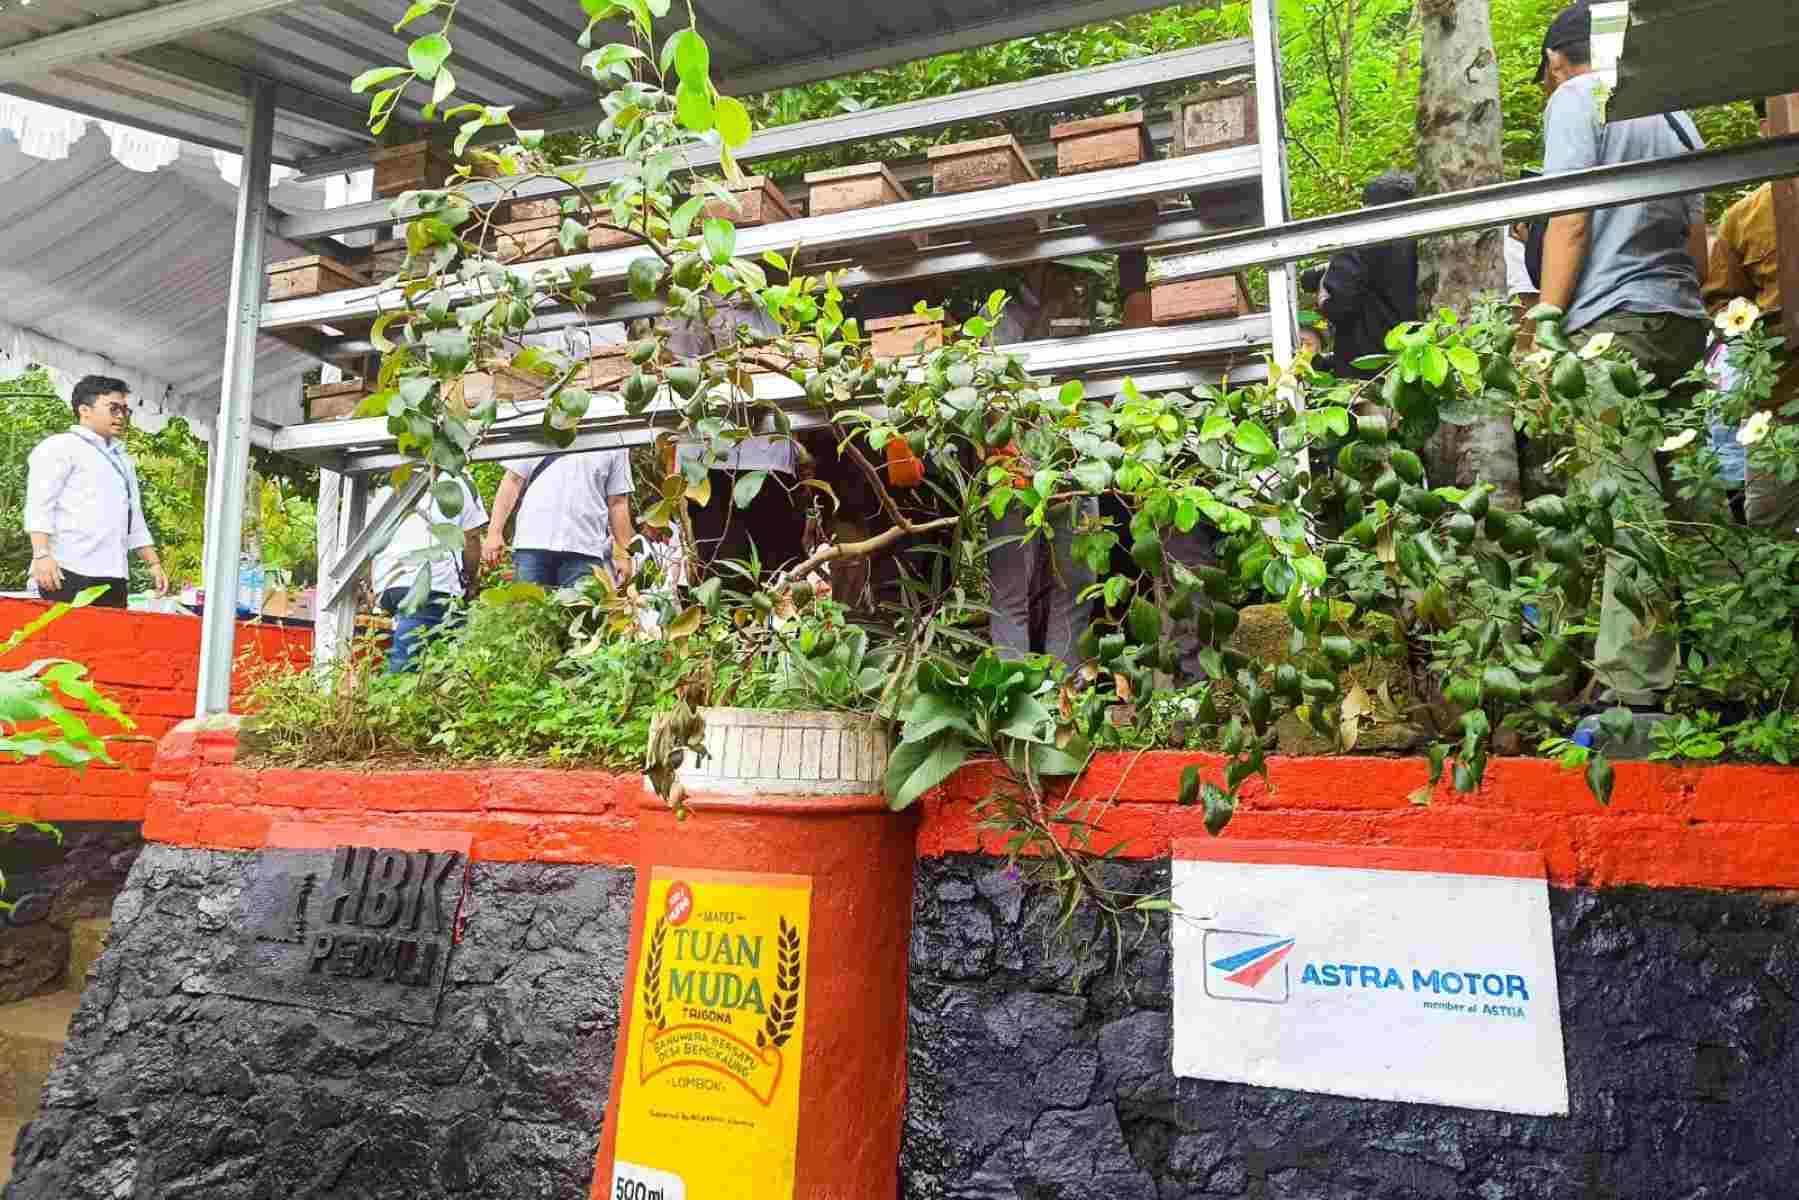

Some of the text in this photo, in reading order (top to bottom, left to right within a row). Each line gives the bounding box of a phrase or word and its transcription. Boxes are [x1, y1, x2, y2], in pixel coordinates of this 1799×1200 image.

[323, 845, 461, 933] HBK
[673, 927, 764, 969] TUAN
[666, 967, 767, 1015] MUDA
[1301, 962, 1530, 1001] ASTRA MOTOR
[681, 1006, 732, 1025] TRIGONA
[1423, 1000, 1464, 1013] member
